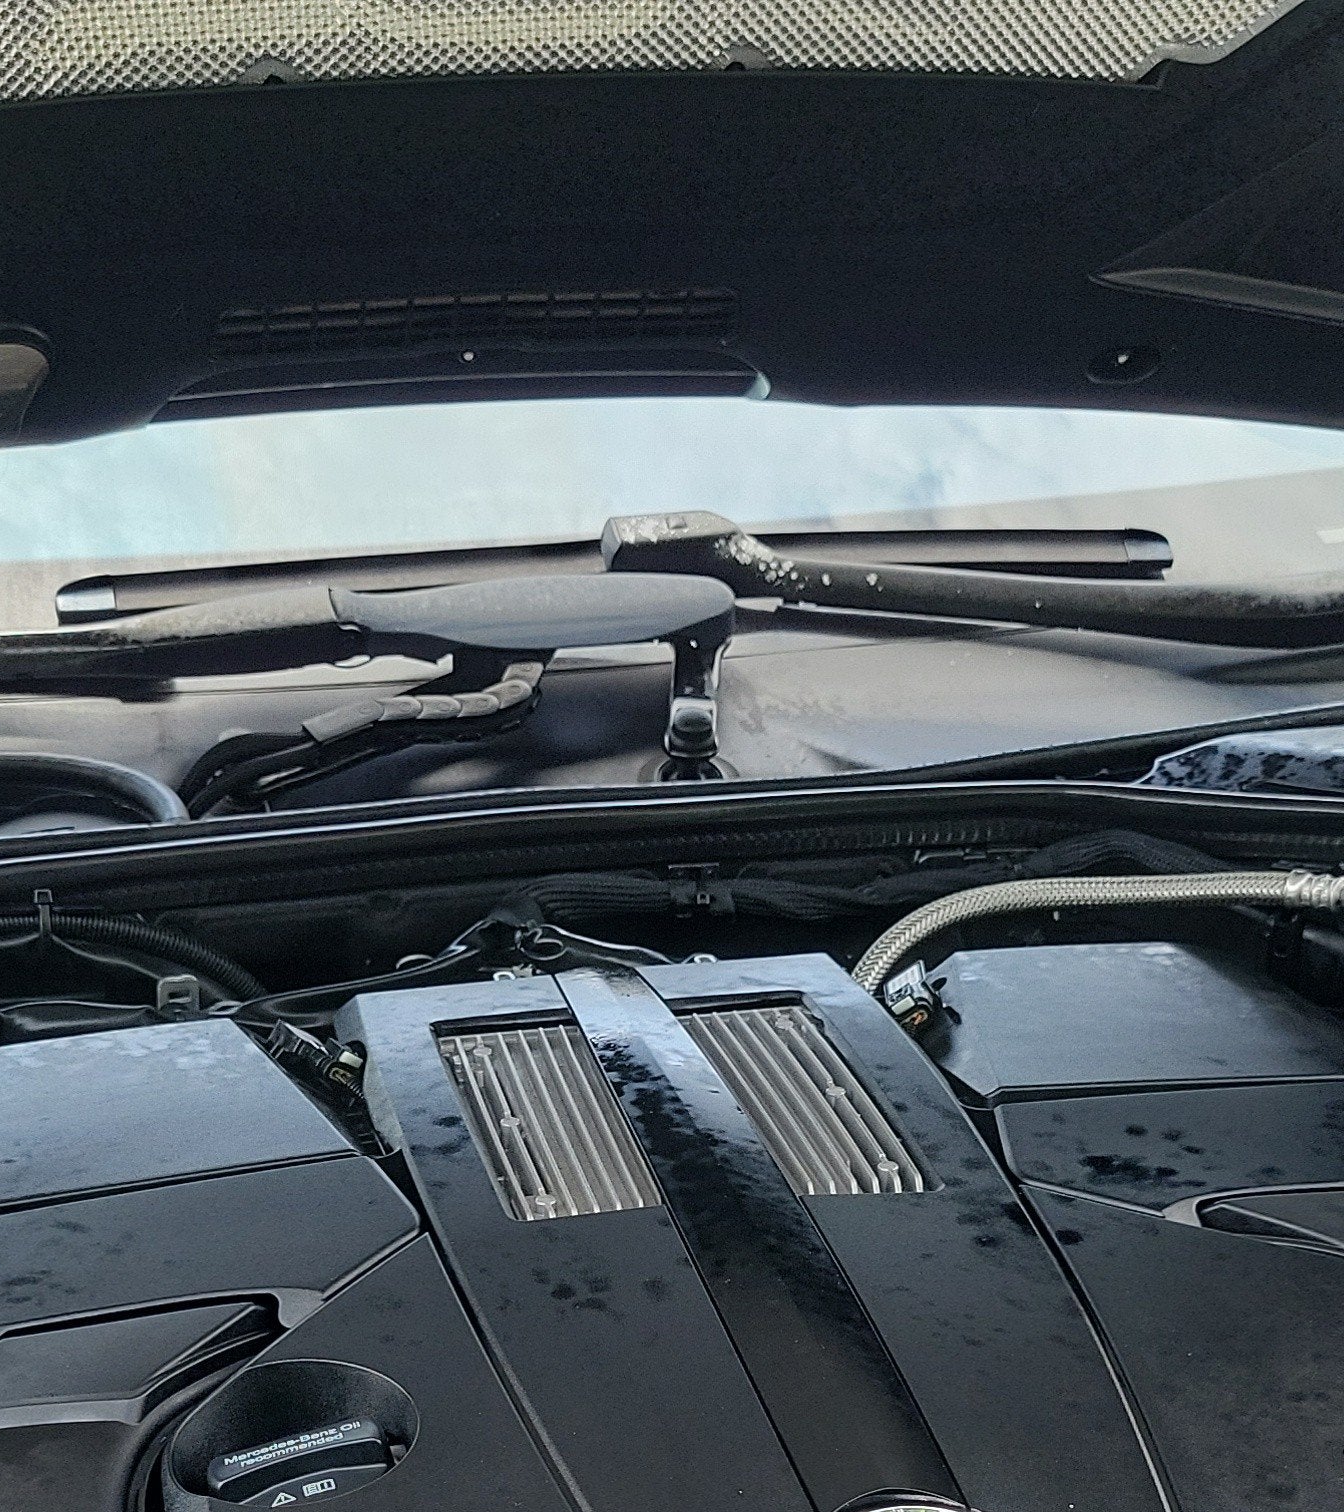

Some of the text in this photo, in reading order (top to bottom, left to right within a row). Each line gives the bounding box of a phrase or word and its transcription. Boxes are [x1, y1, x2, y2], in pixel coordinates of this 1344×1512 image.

[223, 1420, 362, 1466] Mercedes-Benz Oil
[240, 1432, 344, 1468] recommended
